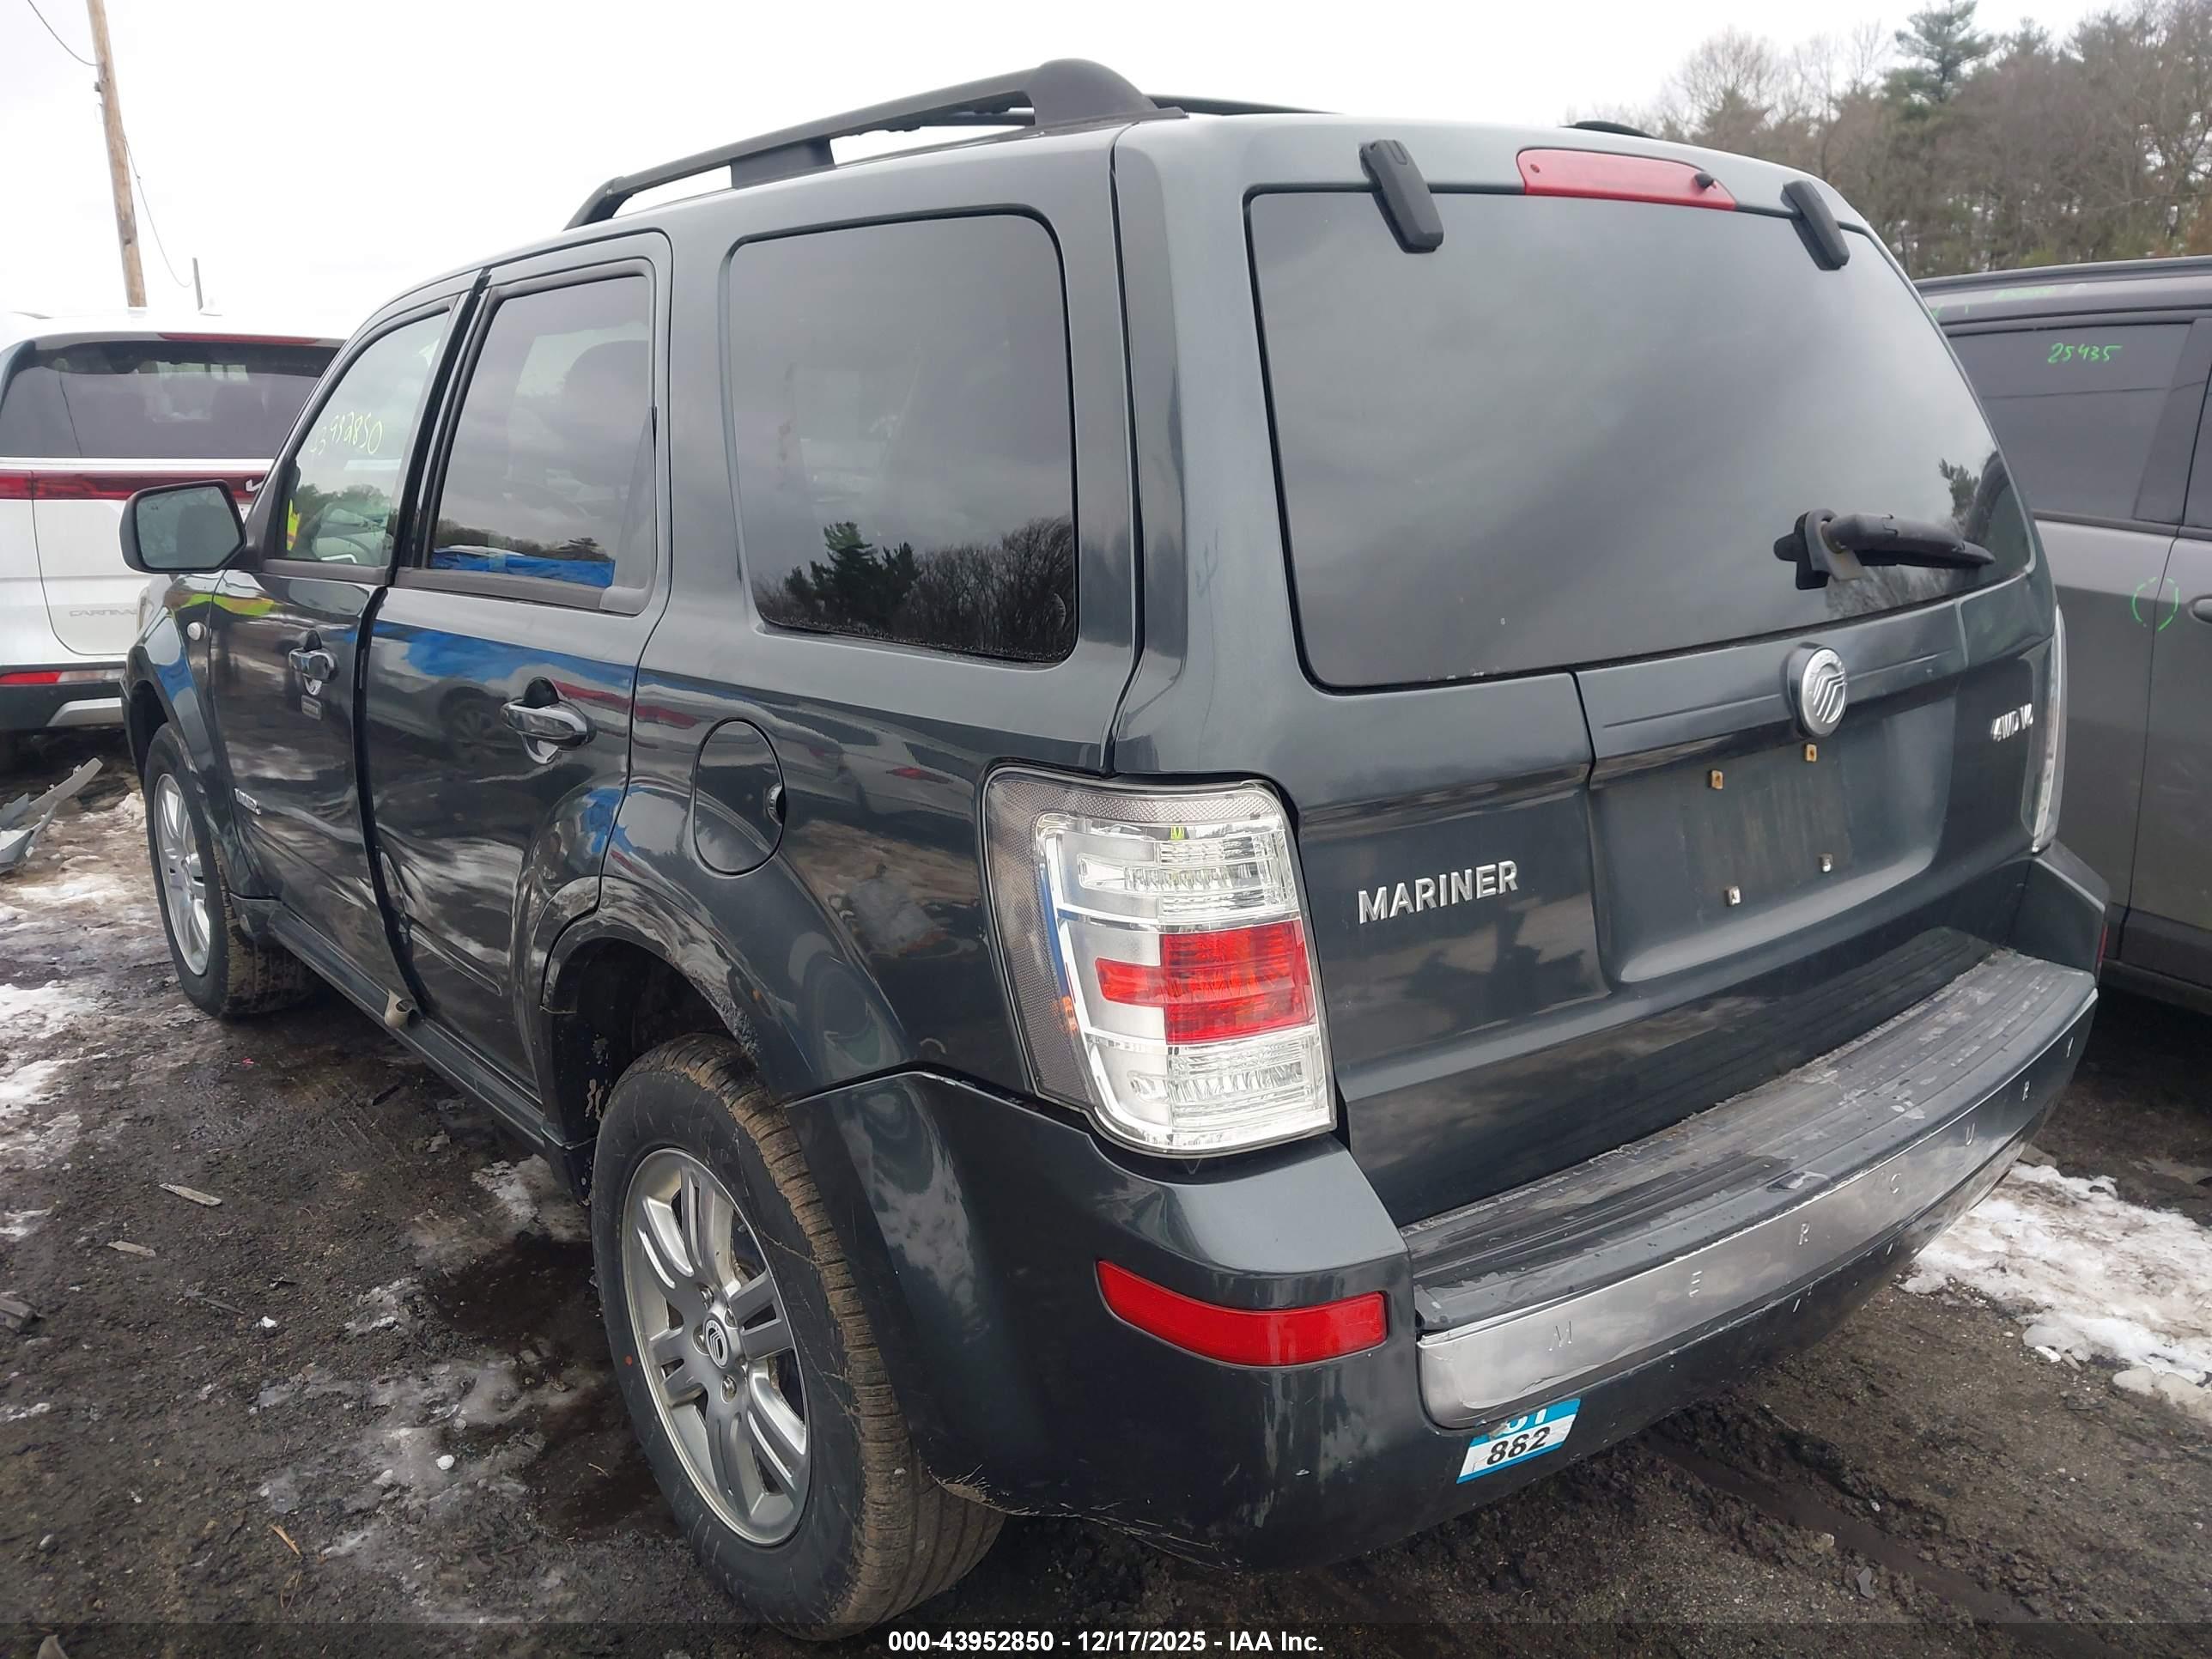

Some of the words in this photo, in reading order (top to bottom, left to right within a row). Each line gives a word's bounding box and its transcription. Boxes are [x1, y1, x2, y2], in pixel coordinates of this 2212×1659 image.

[2047, 342, 2123, 364] 25435
[1357, 860, 1519, 925] MARINER
[1486, 1425, 1551, 1466] 882
